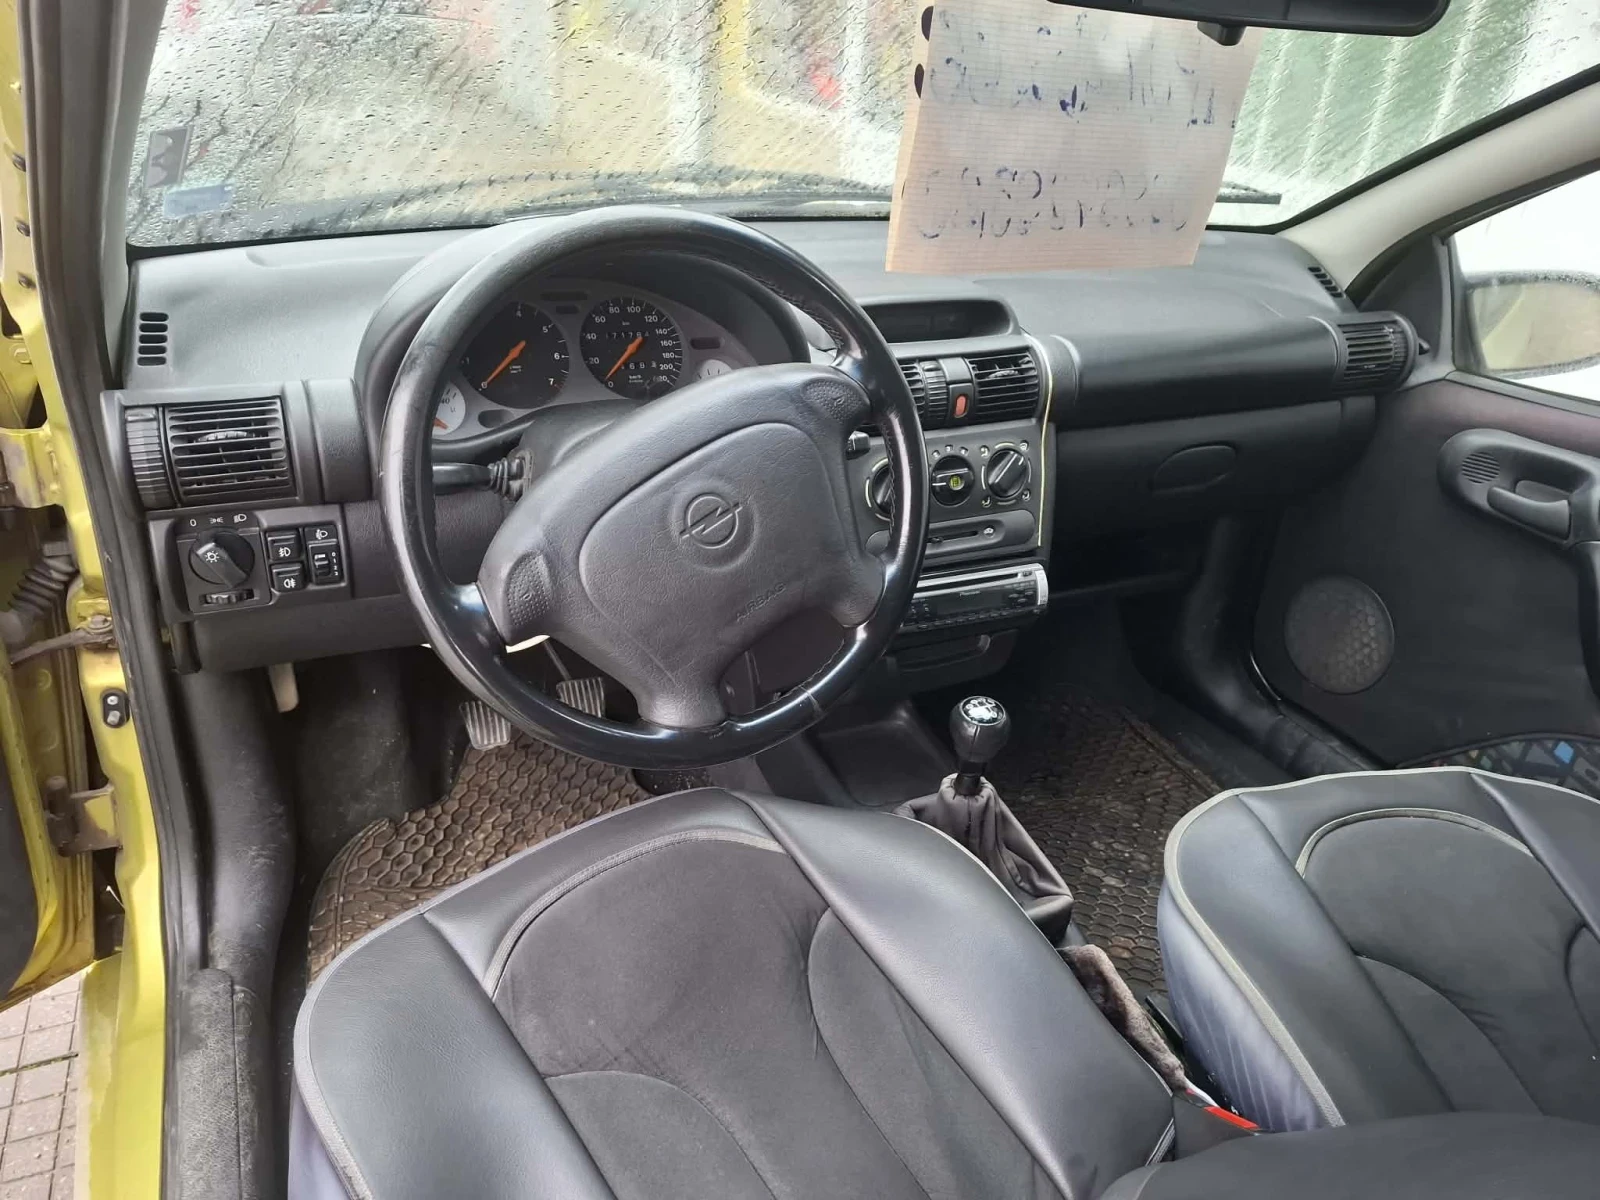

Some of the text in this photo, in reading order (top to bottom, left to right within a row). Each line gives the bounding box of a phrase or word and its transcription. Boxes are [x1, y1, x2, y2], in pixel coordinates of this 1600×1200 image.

[609, 306, 620, 314] 80
[594, 315, 606, 323] 60
[644, 315, 658, 323] 120
[542, 325, 549, 333] 5
[554, 352, 560, 360] 6
[548, 378, 554, 386] 7
[190, 519, 197, 527] 0
